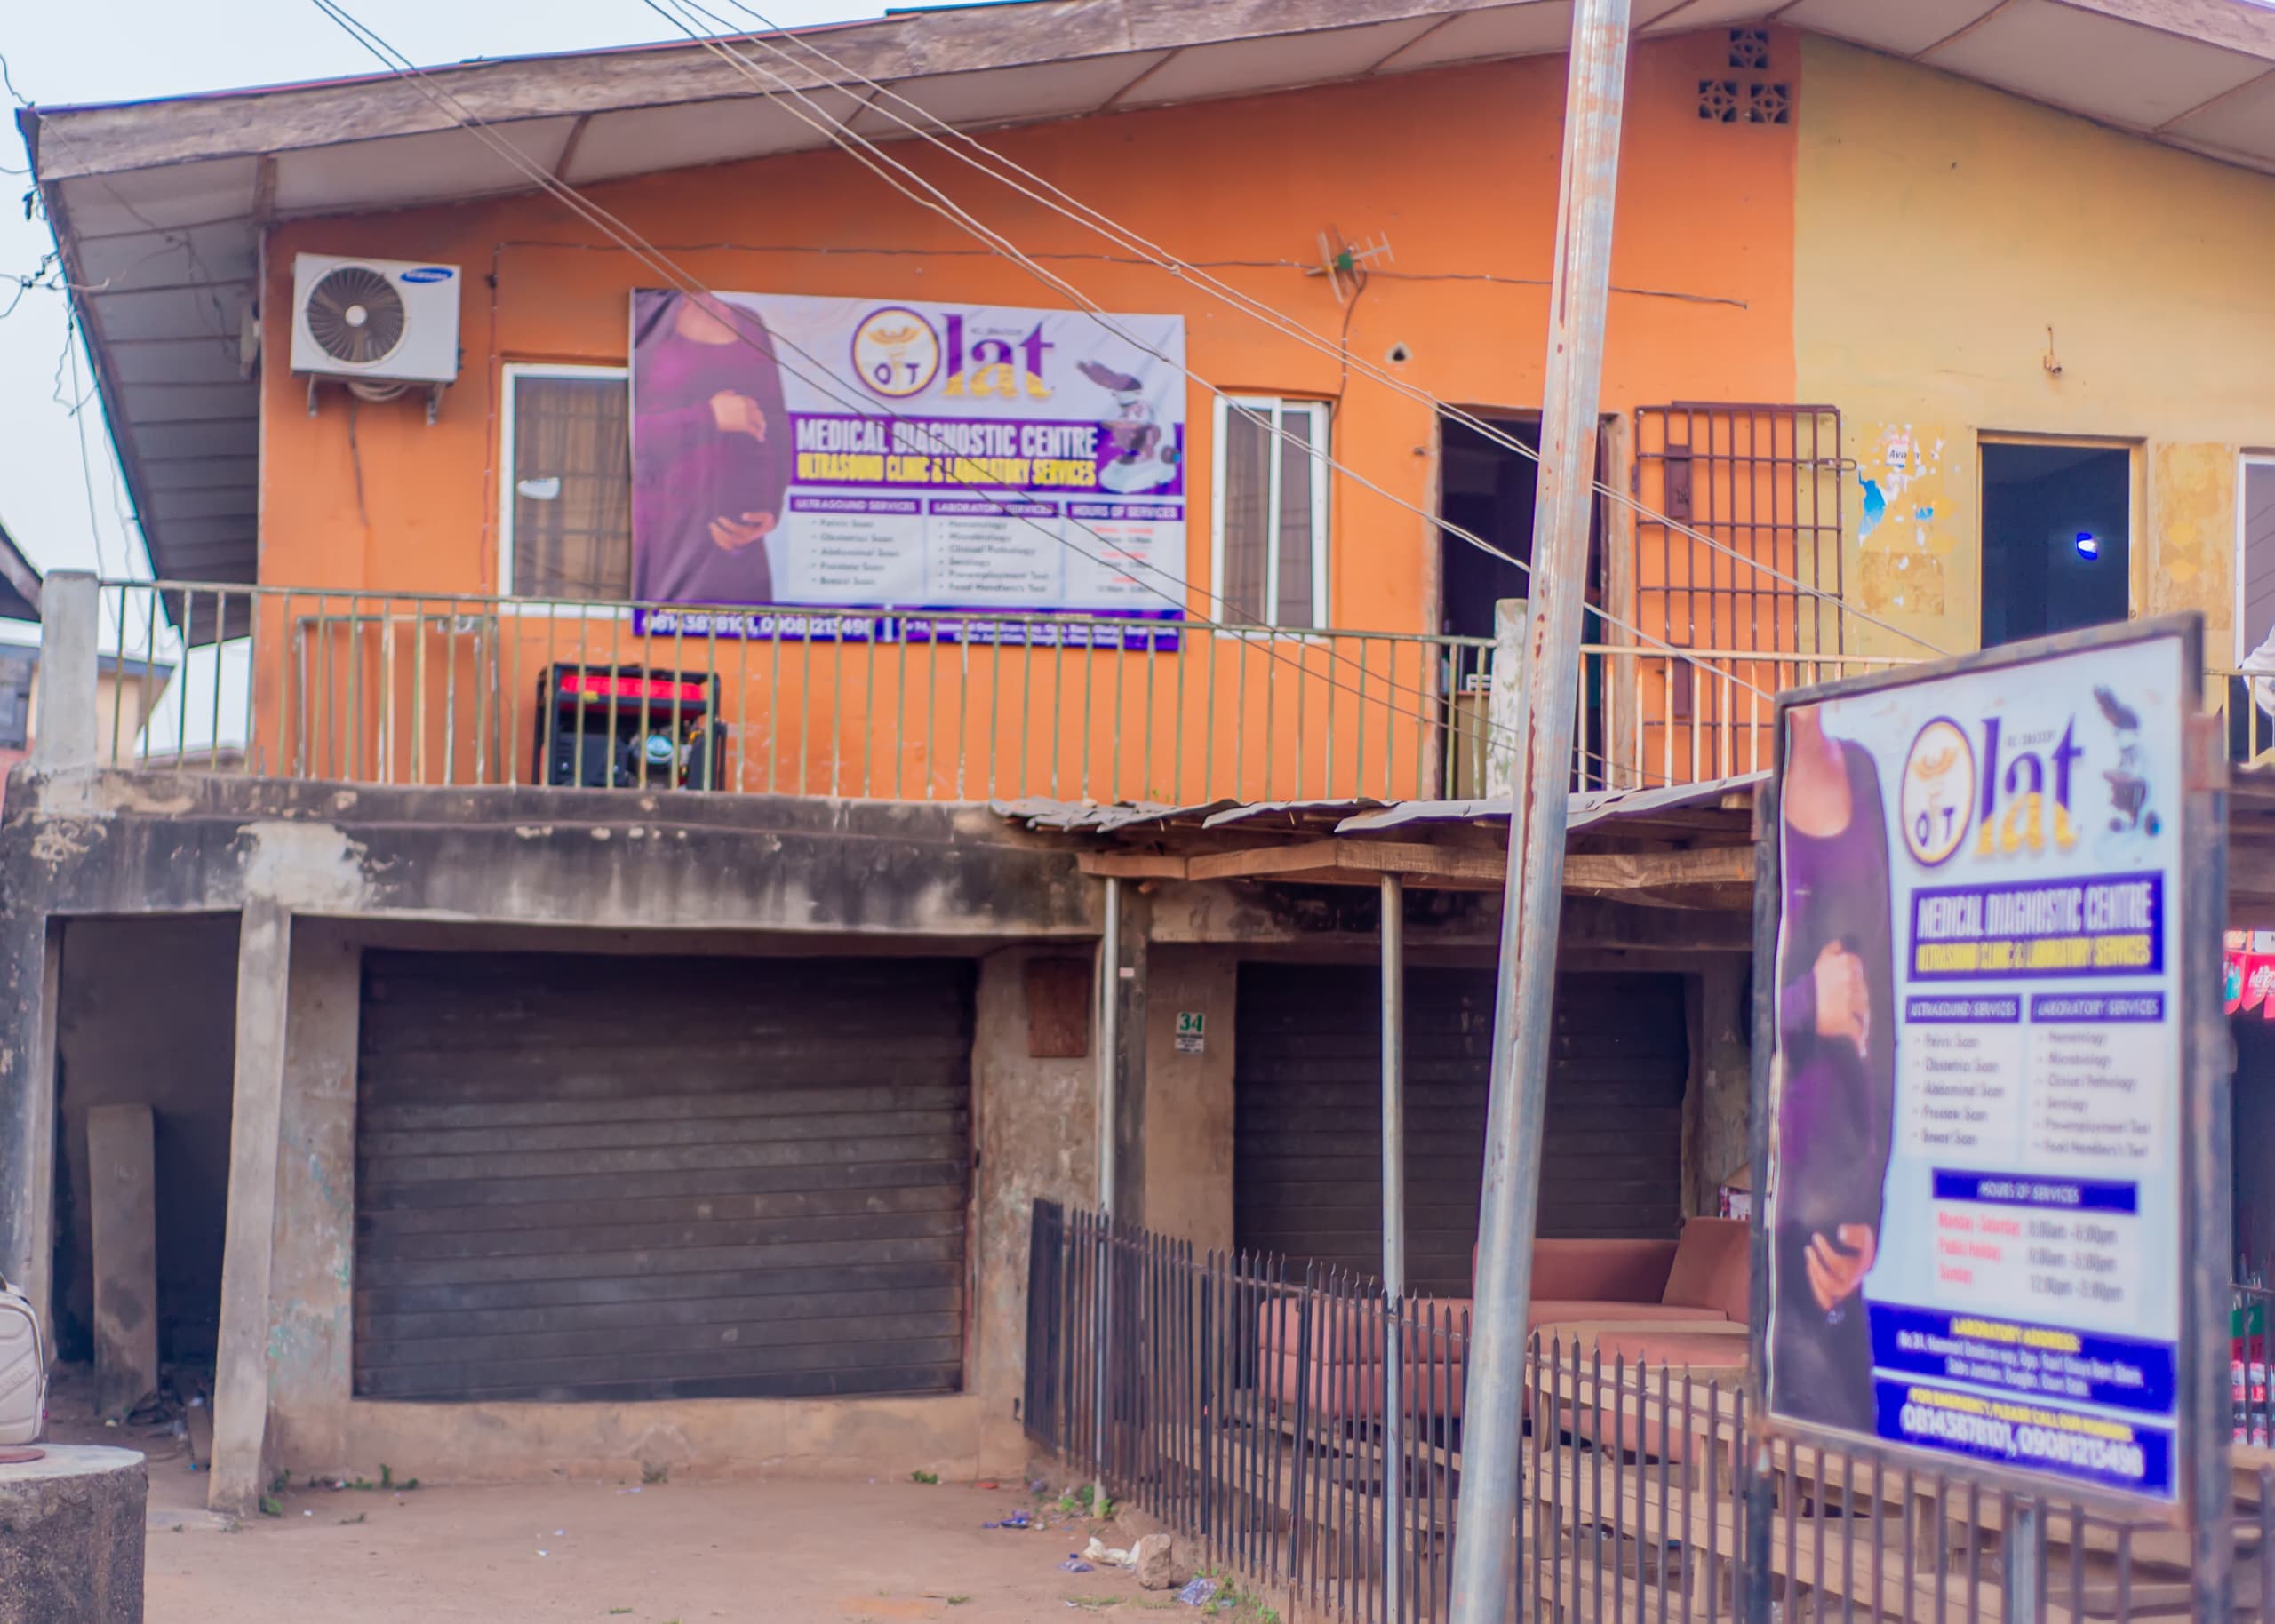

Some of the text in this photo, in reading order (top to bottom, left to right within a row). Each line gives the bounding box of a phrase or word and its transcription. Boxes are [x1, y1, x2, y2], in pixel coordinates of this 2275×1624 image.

[797, 418, 1099, 459] MEDICAL DIAGNOSTIC CENTRE
[1032, 458, 1097, 487] SERVICES
[1917, 881, 2152, 939] MEDICAL DIAGNOSTIC CENTRE
[1911, 1000, 2017, 1018] ULTRASOUND SERVICES
[2038, 999, 2159, 1017] LABORATORY SERVICES
[1179, 1012, 1203, 1032] 34
[1978, 1180, 2080, 1204] HOURS OF SERVICES
